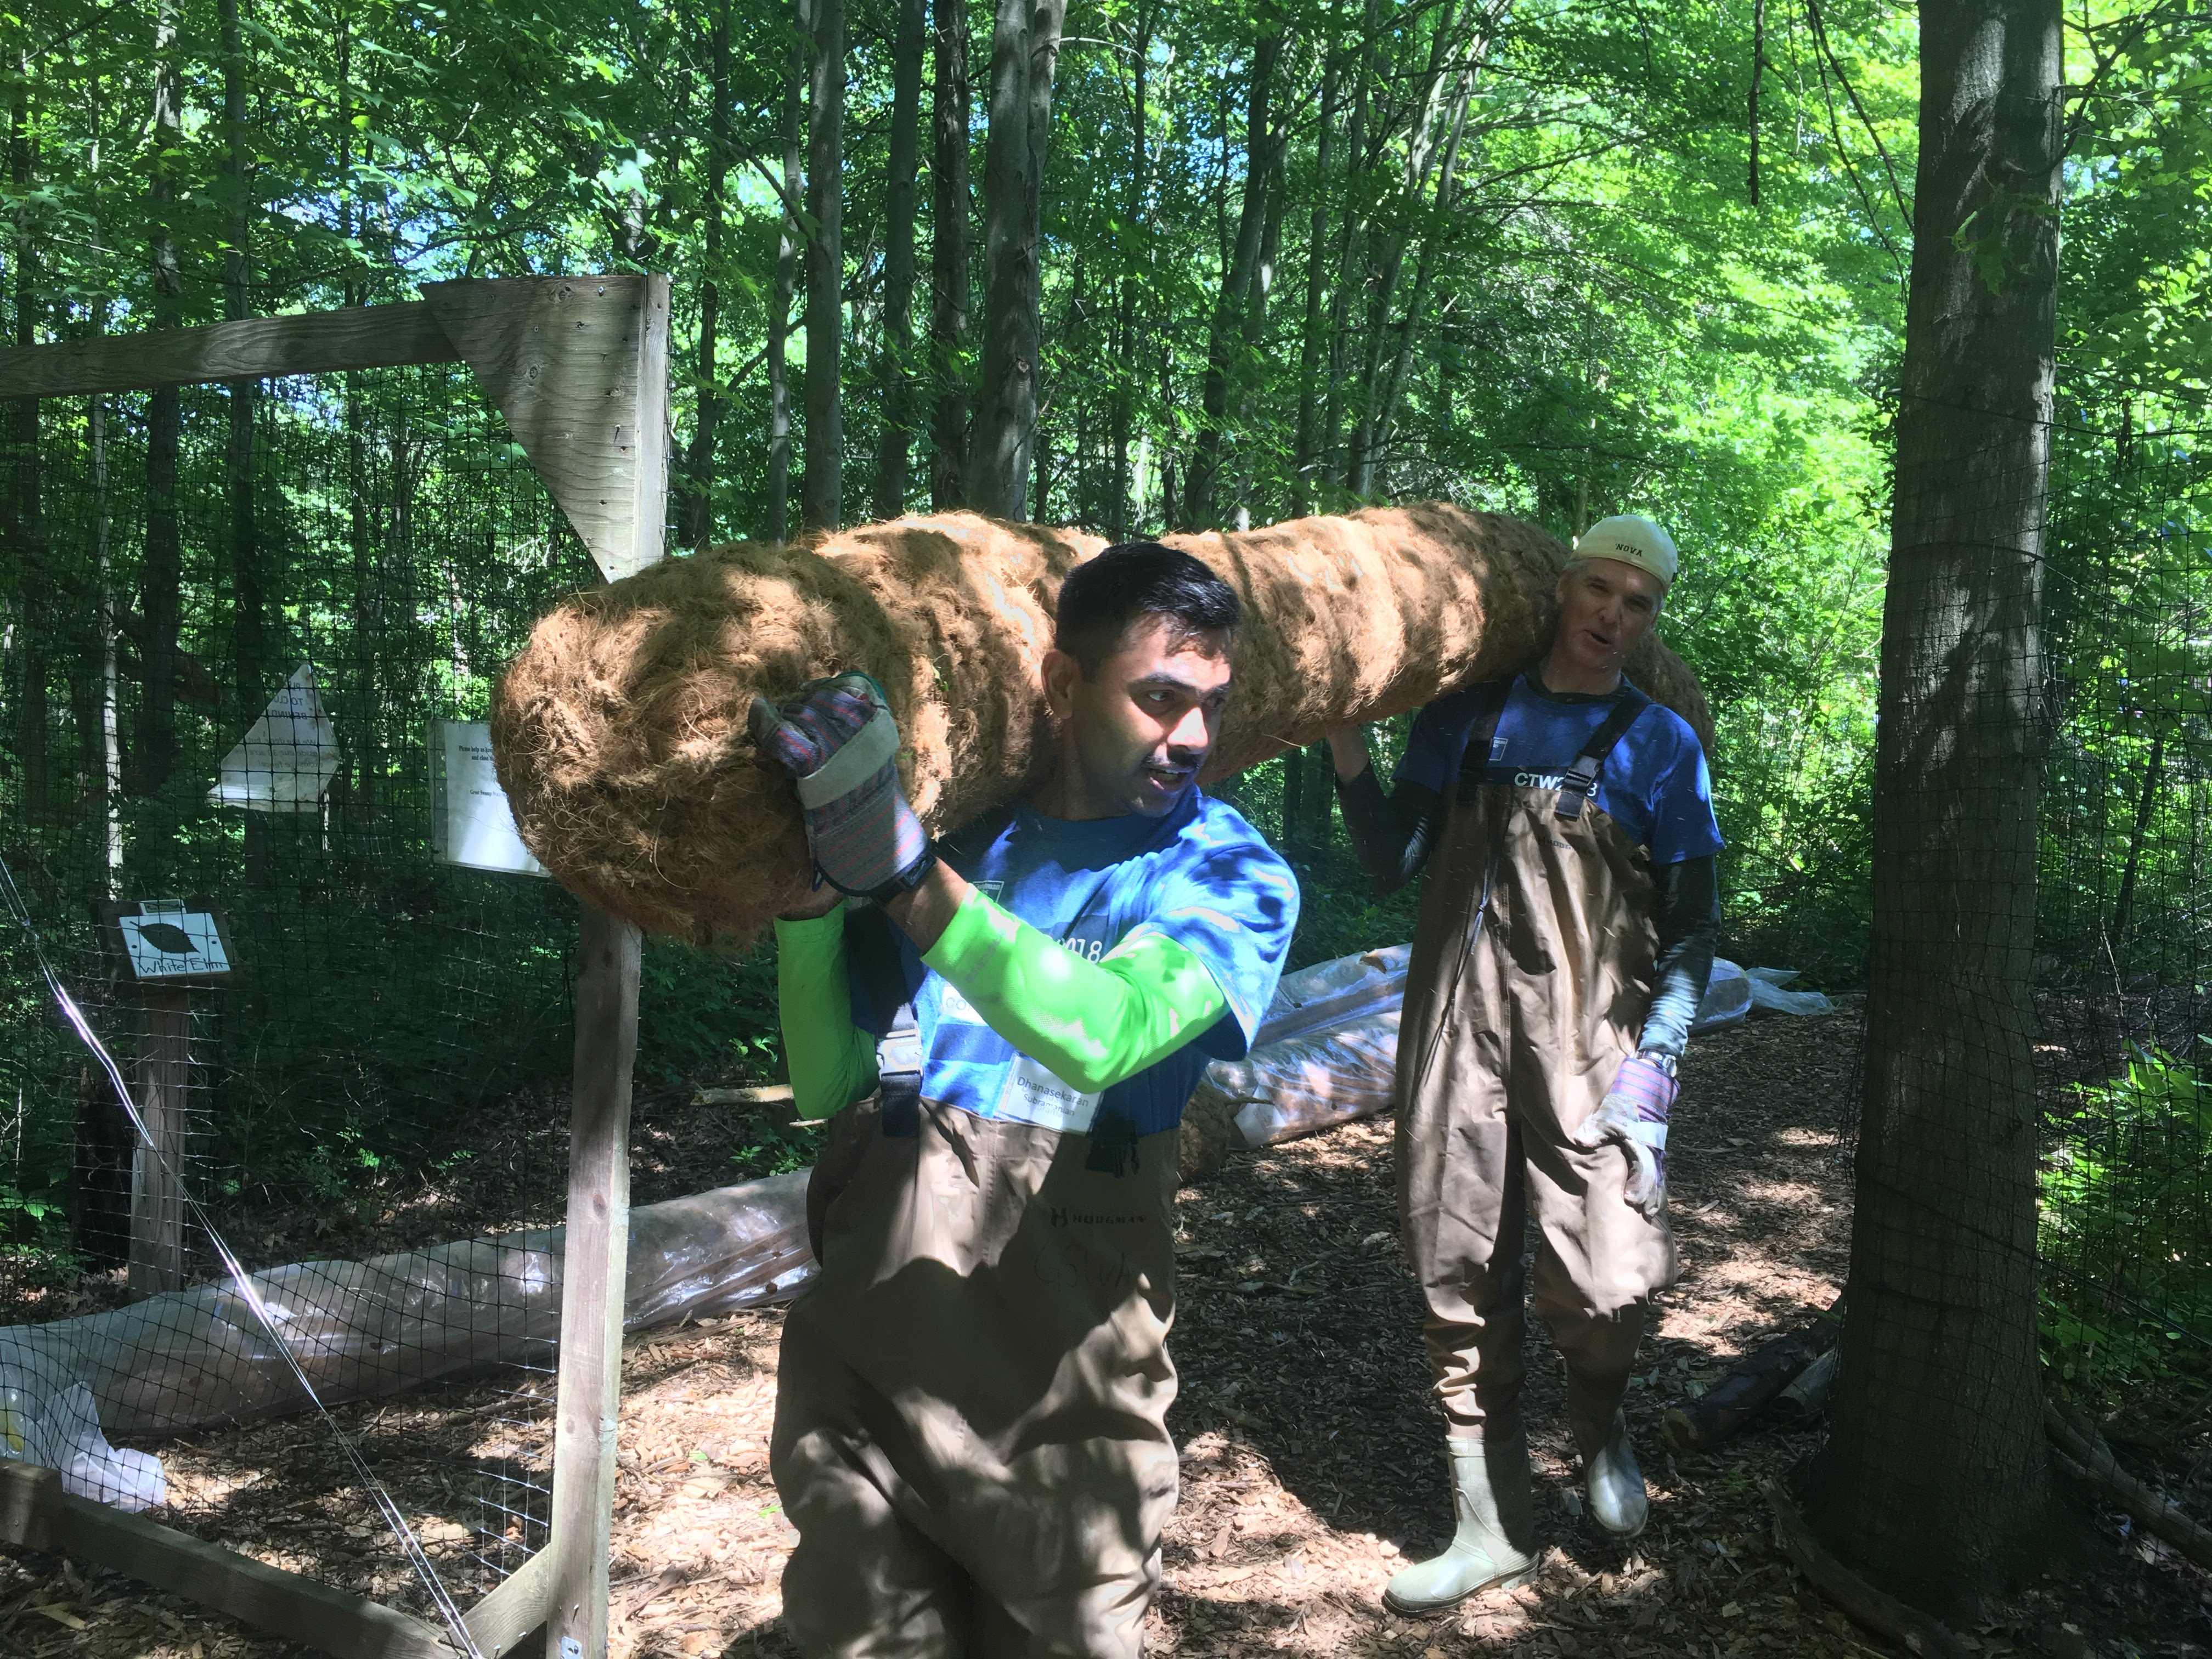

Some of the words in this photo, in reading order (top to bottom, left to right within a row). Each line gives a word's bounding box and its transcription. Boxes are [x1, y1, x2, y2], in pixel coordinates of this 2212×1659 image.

[137, 959, 185, 974] White
[190, 957, 223, 971] Elm
[1017, 1076, 1089, 1108] Dhanasekaran
[1024, 1093, 1075, 1116] Subramanian
